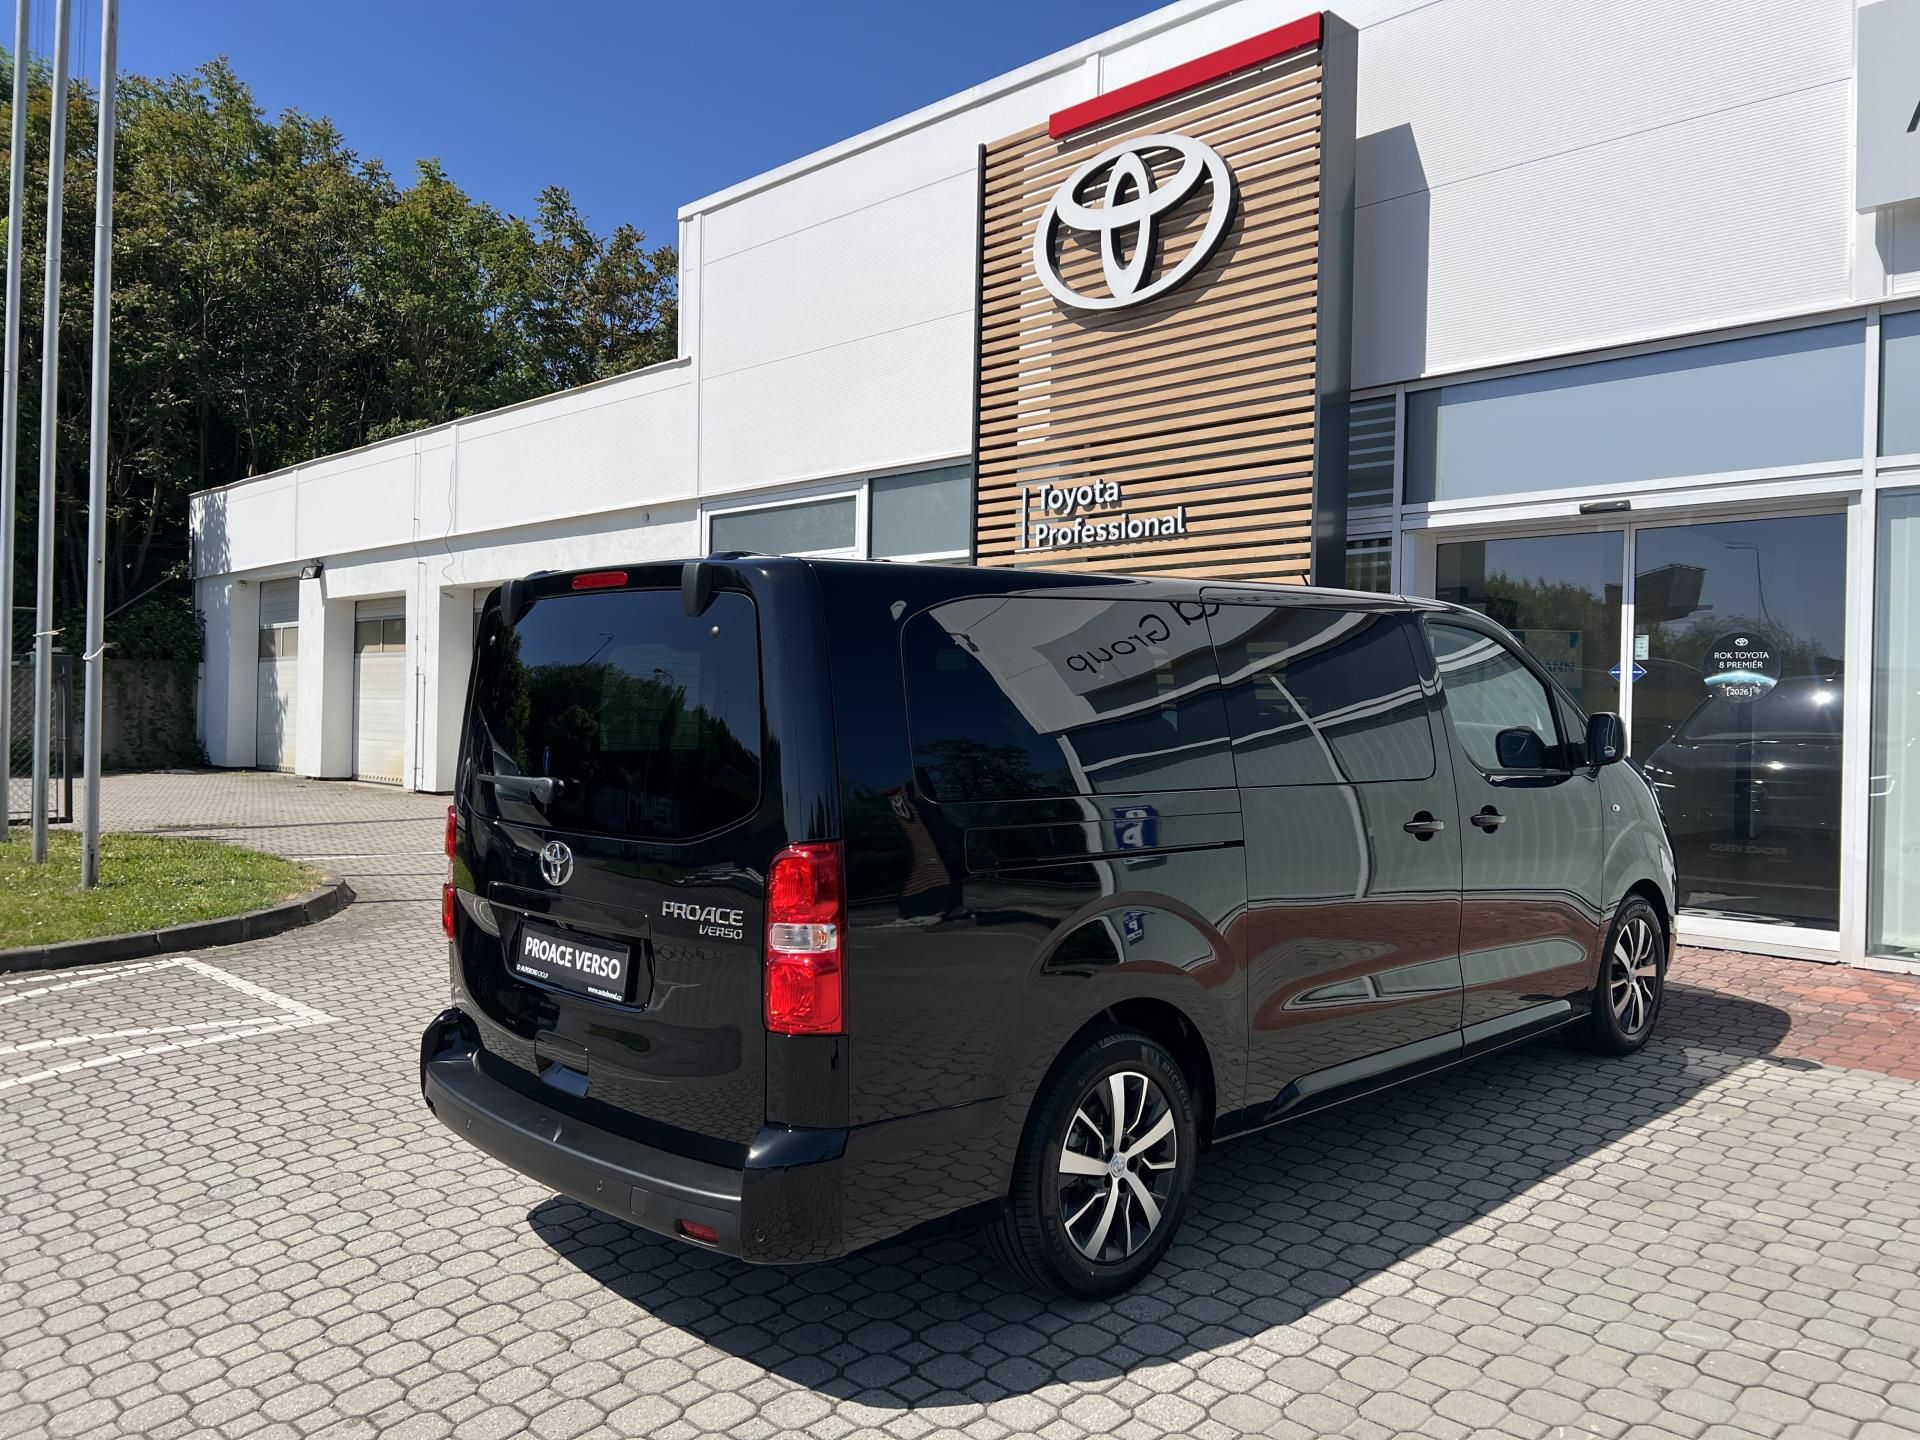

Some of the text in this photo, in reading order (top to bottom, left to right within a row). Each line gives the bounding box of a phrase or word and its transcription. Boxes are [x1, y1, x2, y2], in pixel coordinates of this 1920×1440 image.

[1037, 479, 1120, 514] Toyota
[1035, 506, 1185, 547] Professional
[1714, 651, 1770, 660] ROK TOYOTA
[1718, 661, 1725, 669] 8
[661, 900, 744, 927] PROACE
[699, 924, 743, 940] VERSO
[525, 936, 621, 980] PROACE VERSO
